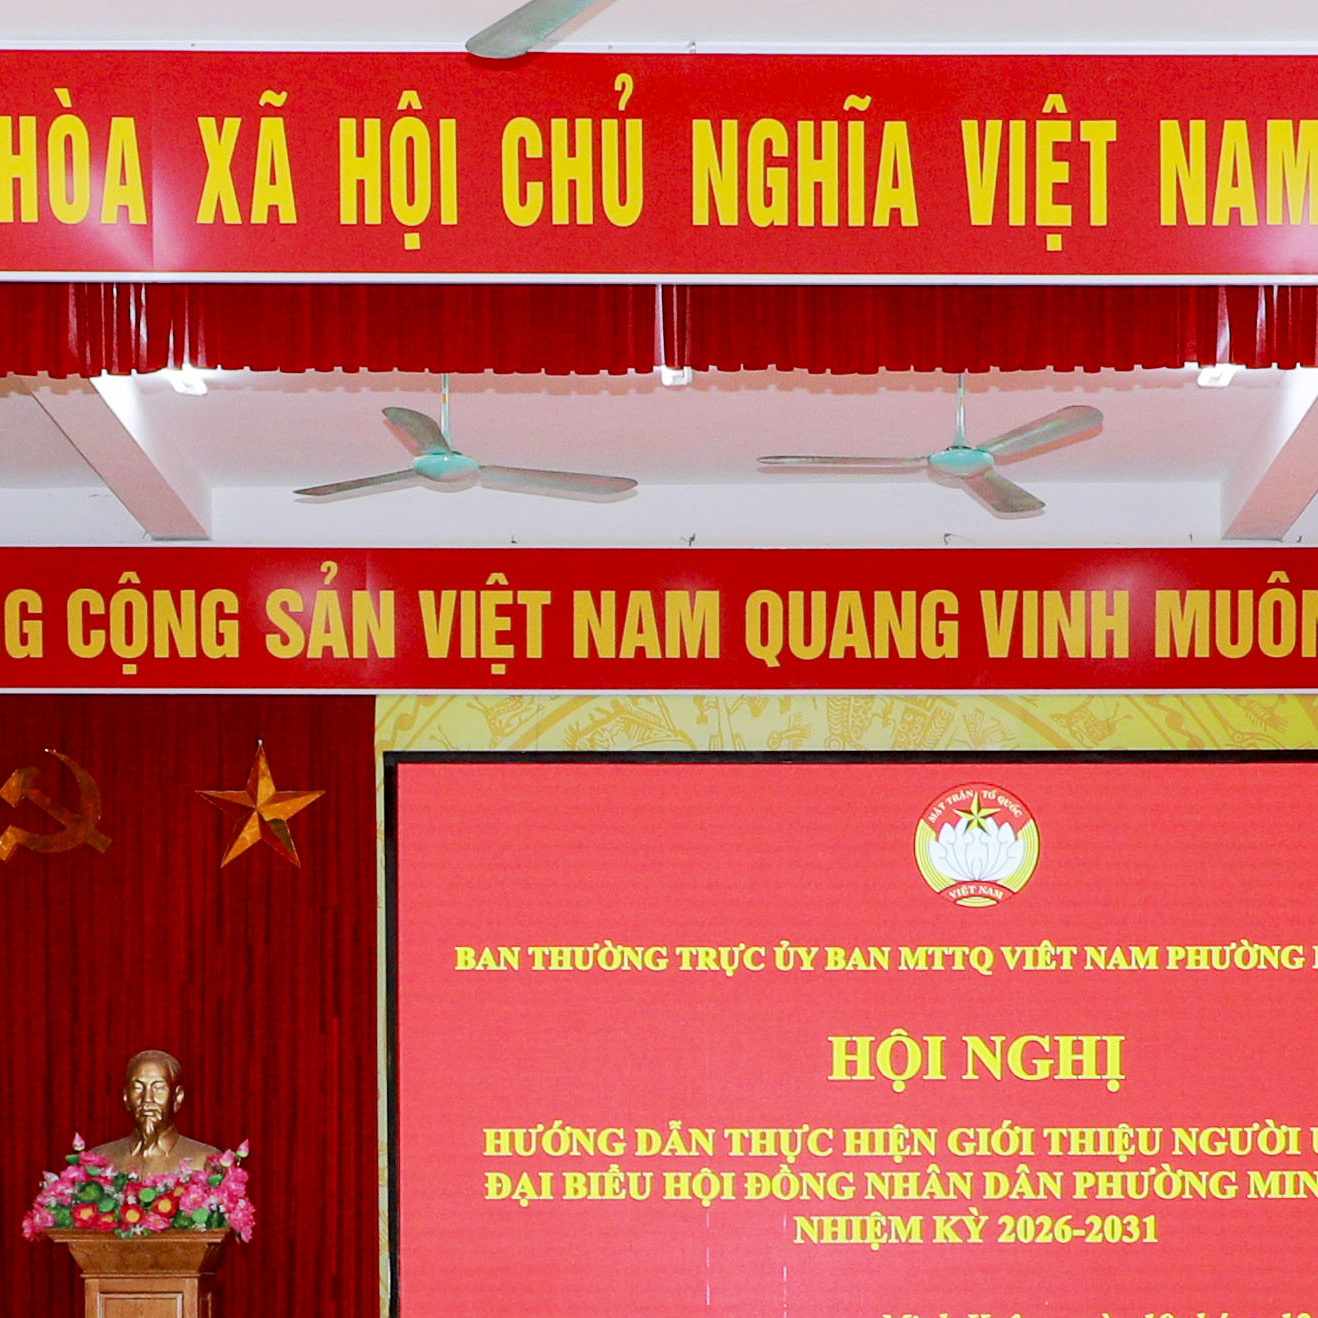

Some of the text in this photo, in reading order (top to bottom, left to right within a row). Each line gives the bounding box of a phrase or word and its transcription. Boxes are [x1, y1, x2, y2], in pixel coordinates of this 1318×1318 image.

[197, 91, 297, 225] XÃ
[340, 91, 457, 249] HỘI
[502, 74, 643, 226] CHỦ
[693, 95, 918, 227] NGHĨA
[962, 94, 1116, 251] VIỆT
[67, 572, 239, 674] CỘNG
[266, 561, 395, 658] SẢN
[419, 573, 551, 674] VIỆT
[574, 591, 719, 658] NAM
[746, 590, 958, 667] QUANG
[980, 590, 1129, 658] VINH
[978, 885, 1004, 900] NAM
[454, 946, 522, 971] BAN
[527, 939, 670, 971] THƯỜNG
[674, 942, 766, 977] TRỰC
[772, 939, 820, 972] ỦY
[824, 946, 892, 971] BAN
[897, 945, 995, 976] MTTQ
[1083, 945, 1160, 970] NAM
[1165, 939, 1306, 970] PHƯỜNG
[827, 1027, 1126, 1093] HỘI NGHỊ
[482, 1119, 627, 1157] HƯỚNG
[634, 1119, 717, 1157] DẪN
[723, 1123, 835, 1164] THỰC
[842, 1123, 939, 1163] HIỆN
[947, 1119, 1035, 1157] GIỚI
[1042, 1122, 1163, 1163] THIỆU
[1170, 1118, 1302, 1156] NGƯỜI
[484, 1171, 555, 1208] ĐẠI
[662, 1167, 737, 1208] HỘI
[743, 1163, 857, 1201] ĐỒNG
[863, 1164, 973, 1200] NHÂN
[982, 1164, 1065, 1200] DÂN
[1072, 1162, 1239, 1200] PHƯỜNG
[792, 1206, 1159, 1251] NHIỆM KỲ 2026-2031
